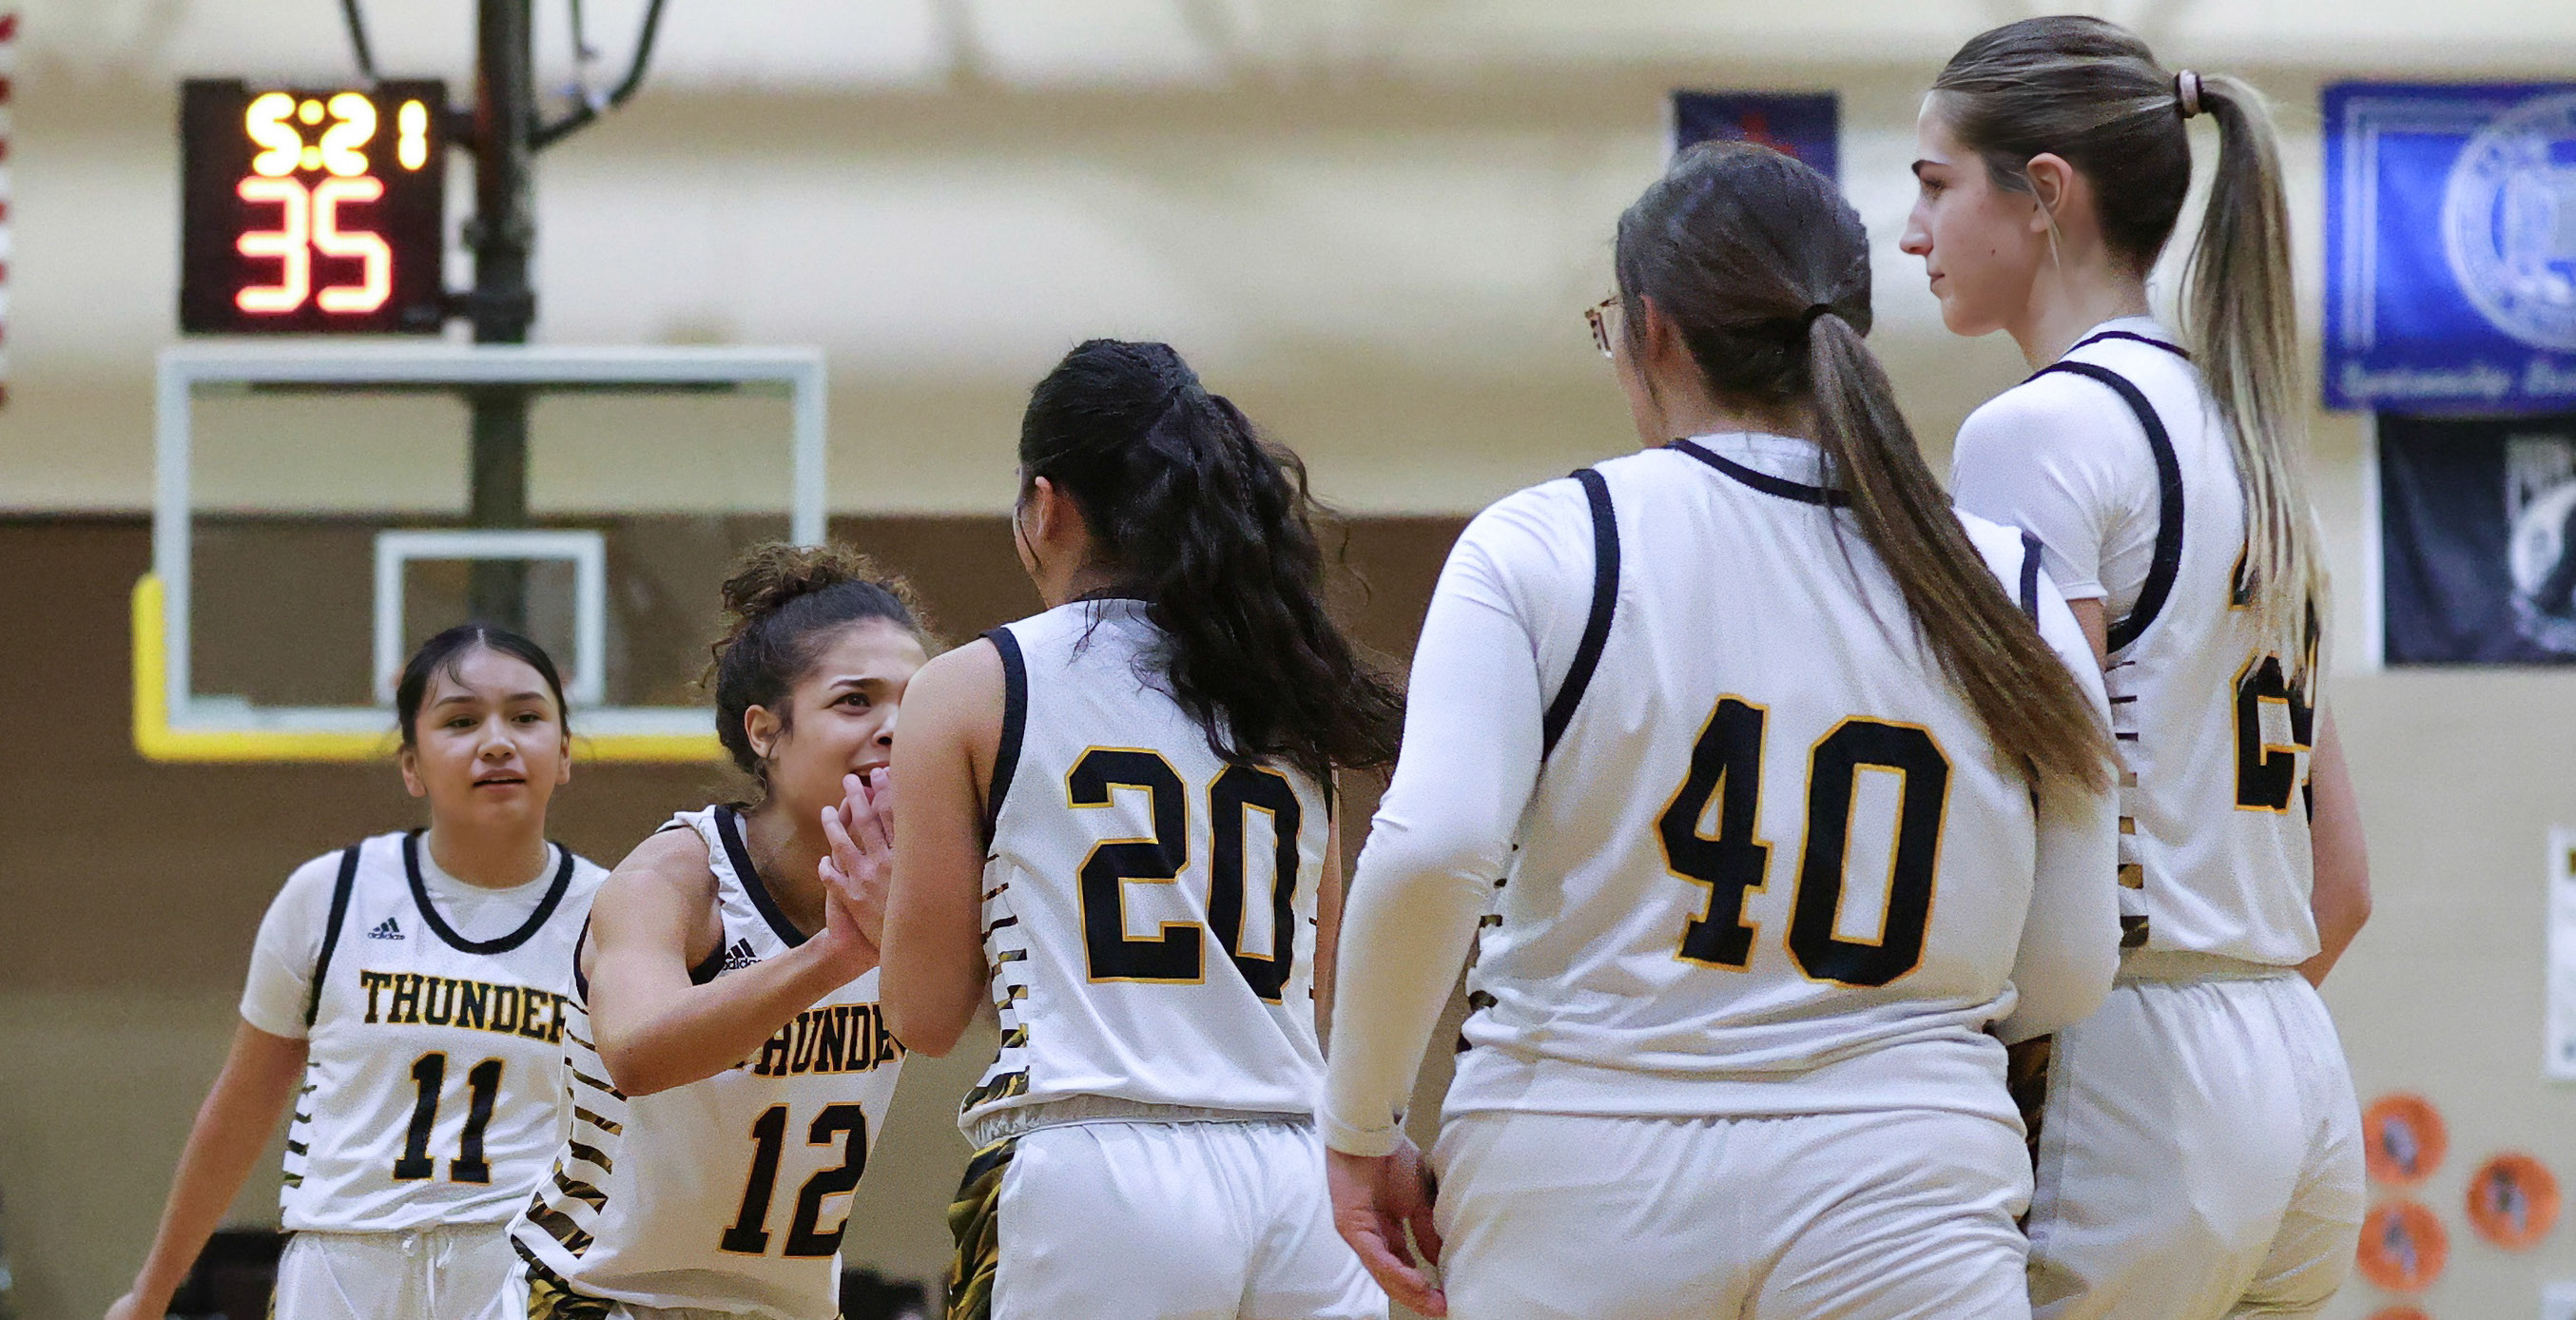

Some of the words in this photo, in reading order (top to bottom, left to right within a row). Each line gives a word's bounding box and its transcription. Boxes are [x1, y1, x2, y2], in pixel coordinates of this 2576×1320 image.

[245, 92, 427, 177] 5:21
[236, 175, 392, 313] 35
[1064, 746, 1304, 1005] 20
[1653, 693, 1955, 989] 40
[734, 1001, 898, 1078] HUNDE
[393, 1051, 506, 1185] 11
[716, 1102, 869, 1259] 12
